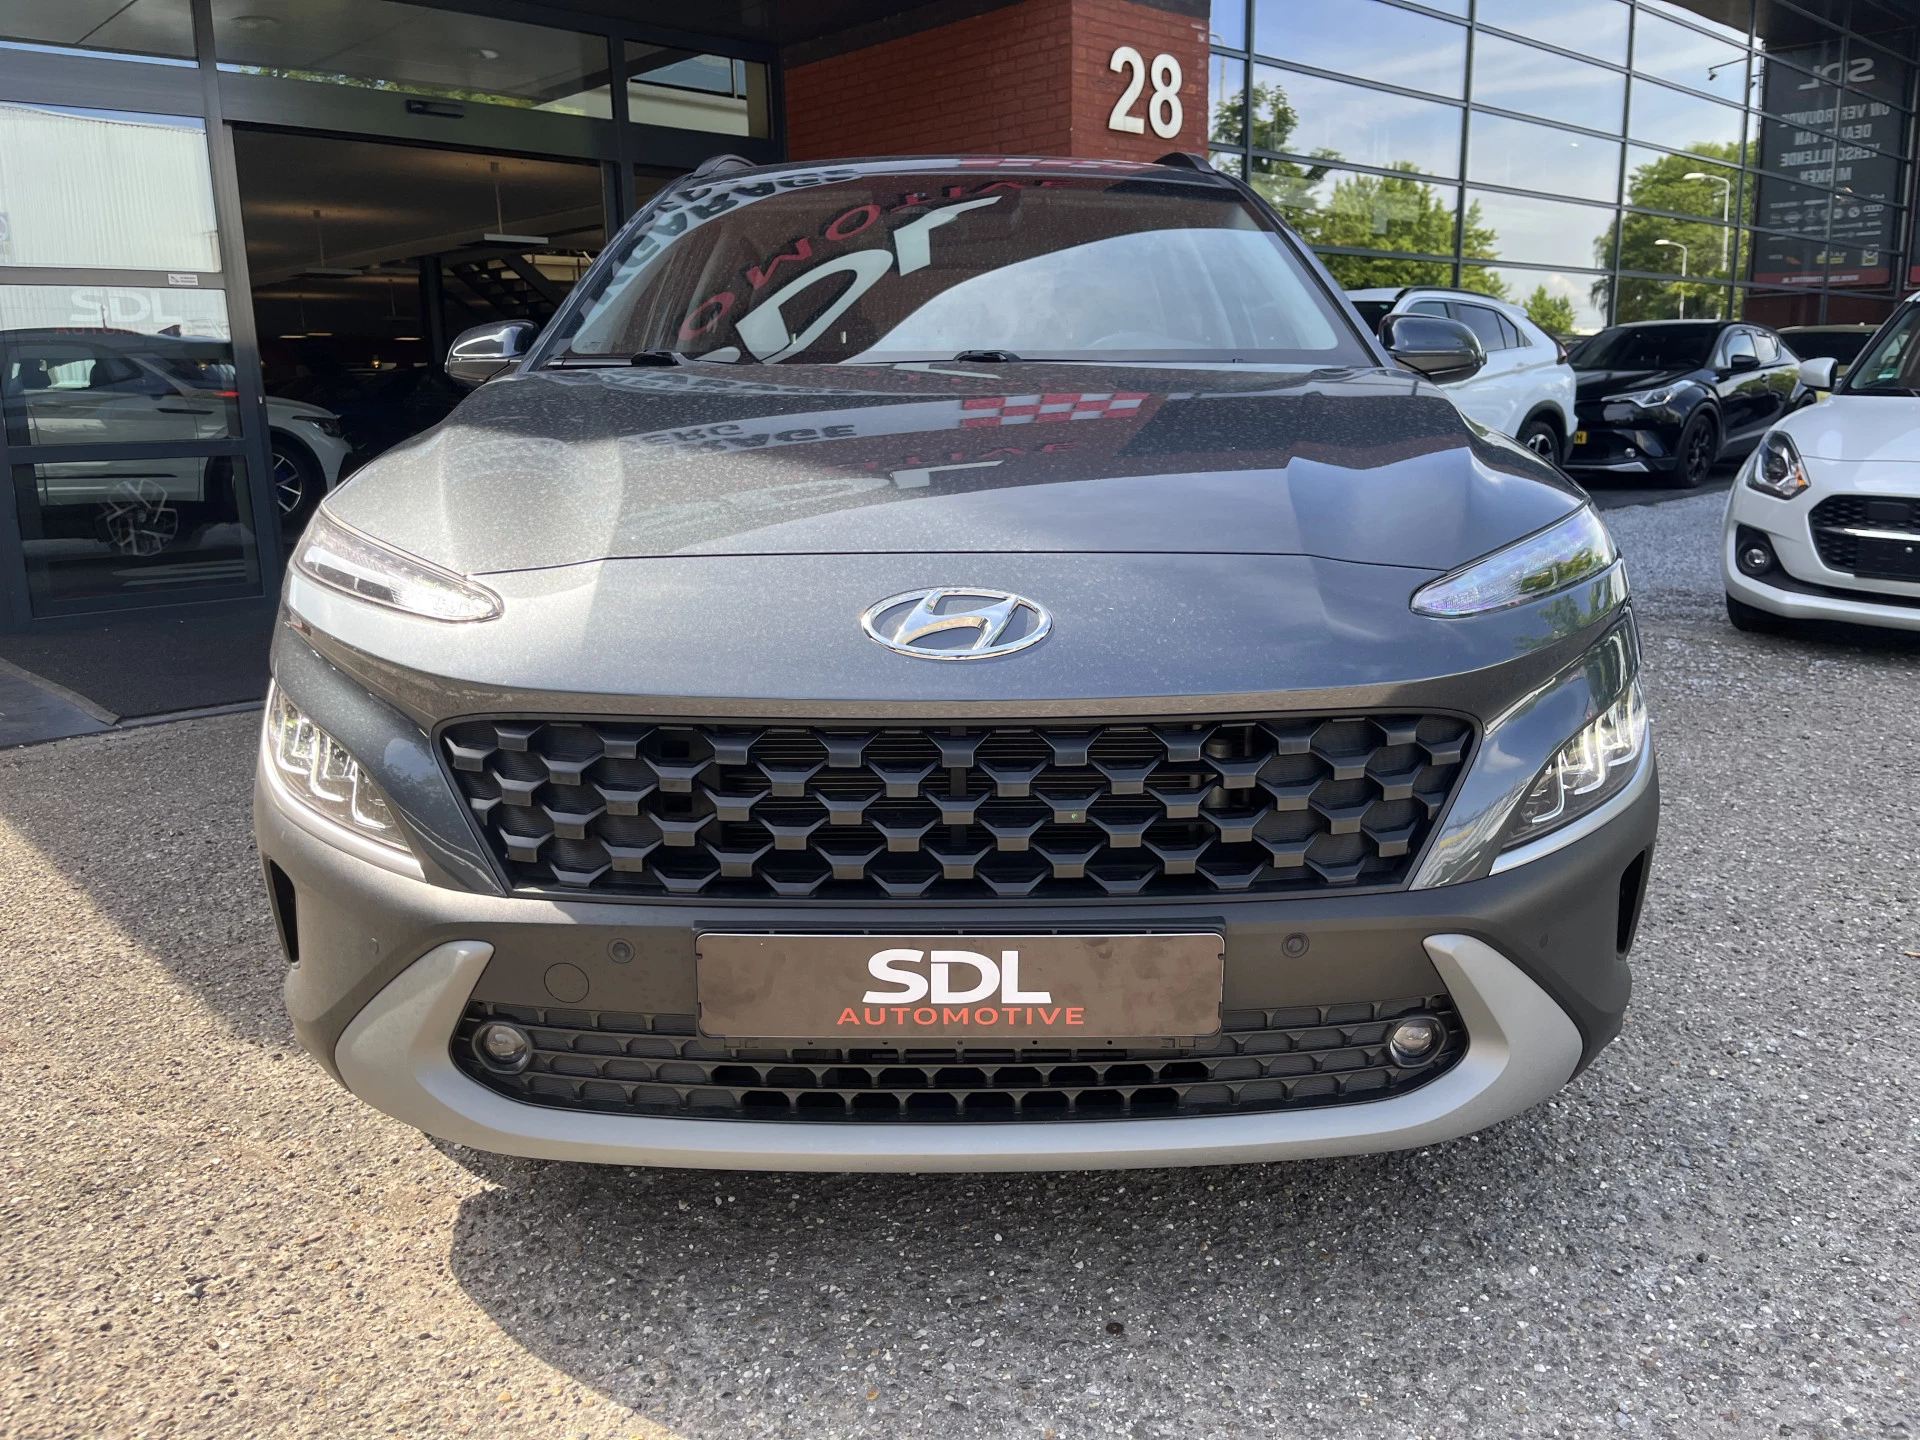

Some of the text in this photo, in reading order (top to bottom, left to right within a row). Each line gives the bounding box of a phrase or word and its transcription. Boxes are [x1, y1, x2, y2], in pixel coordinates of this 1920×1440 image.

[1108, 46, 1183, 139] 28
[69, 289, 183, 324] SDL
[862, 949, 1052, 1004] SDL
[837, 1007, 1084, 1025] AUTOMOTIVE
